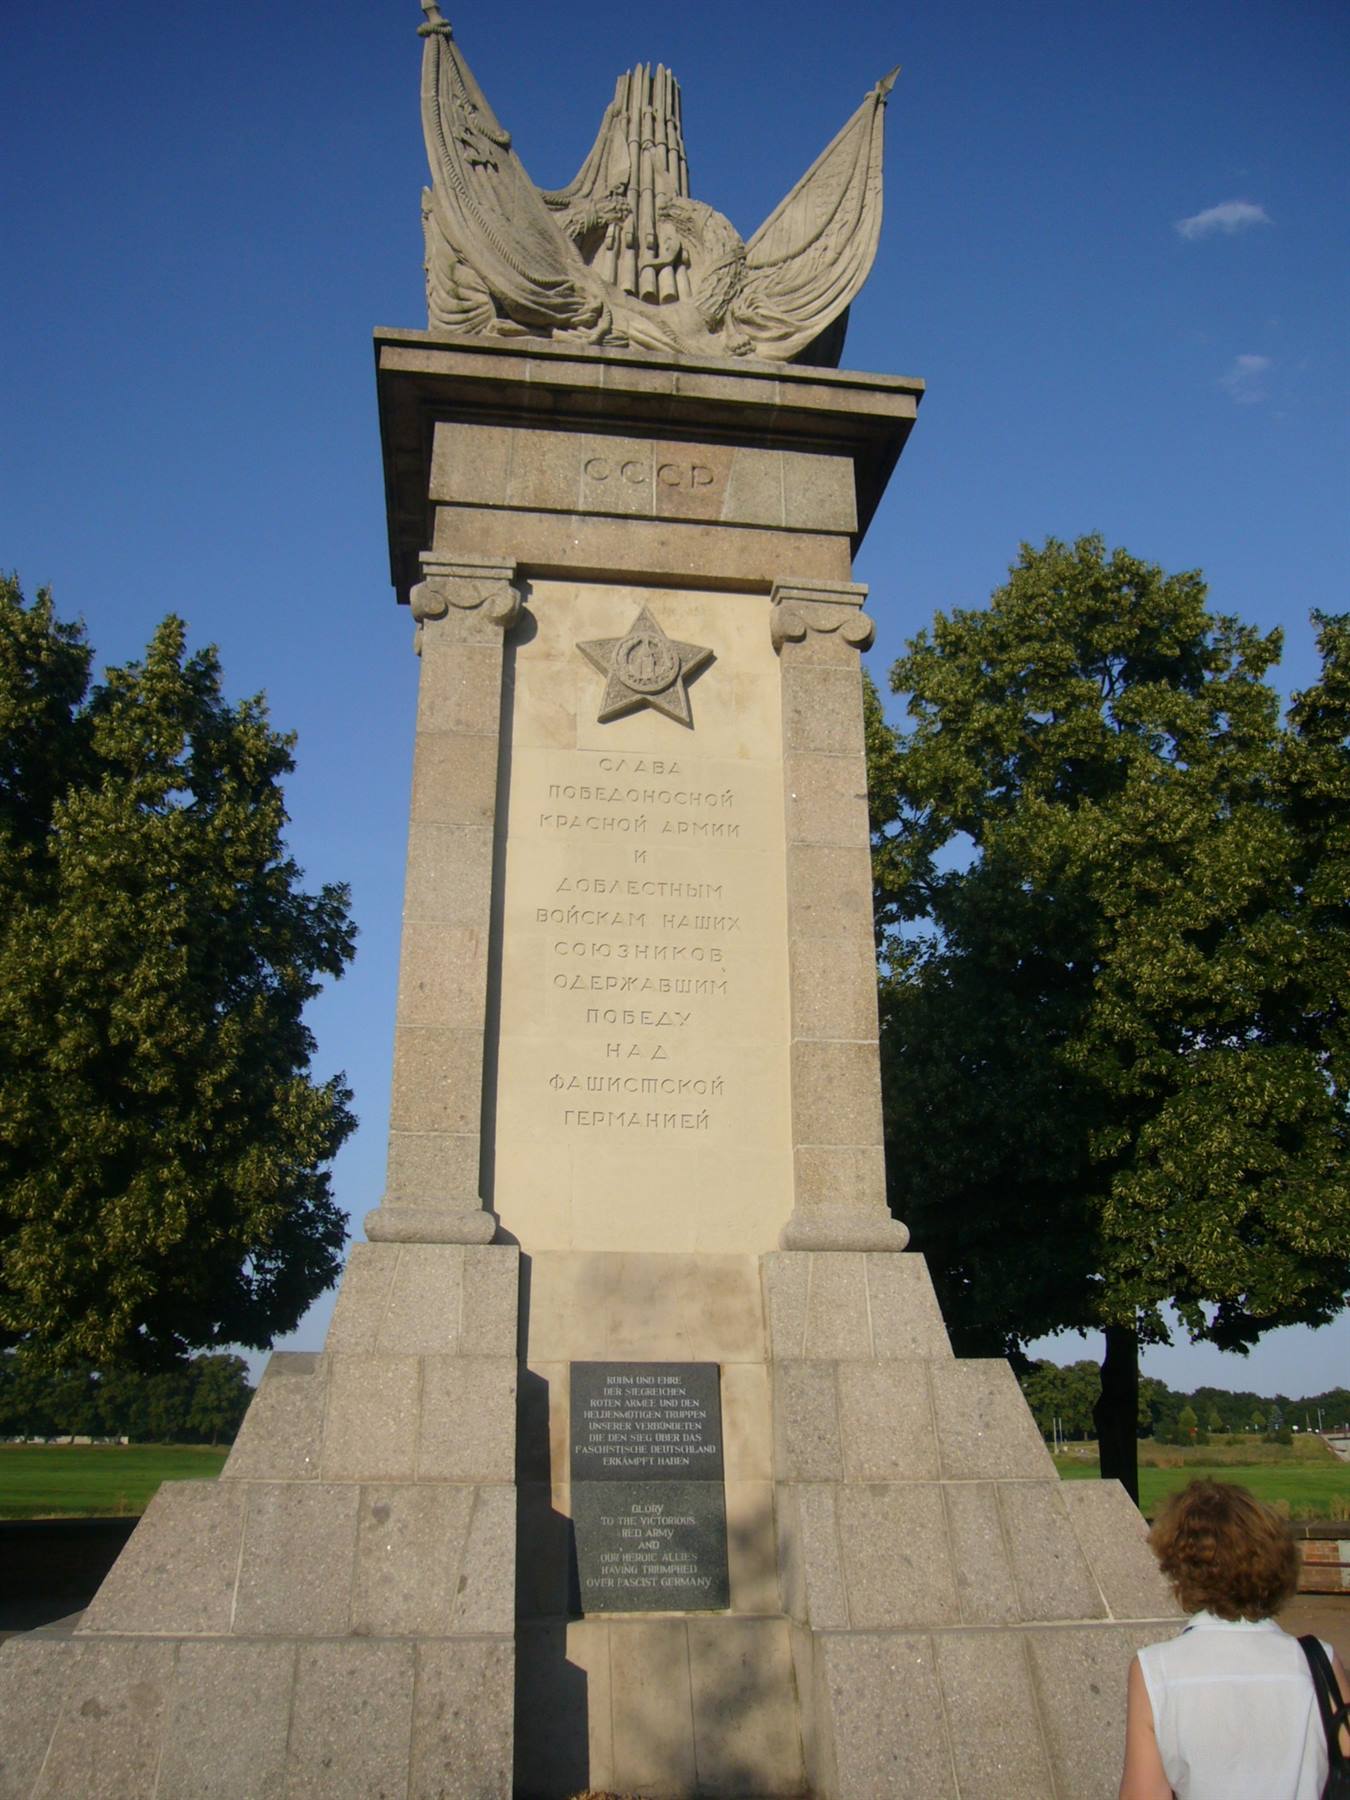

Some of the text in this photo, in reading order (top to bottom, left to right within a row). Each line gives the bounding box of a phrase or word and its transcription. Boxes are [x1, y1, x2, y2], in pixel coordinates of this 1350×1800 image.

[584, 457, 714, 488] СССР
[599, 758, 682, 775] СЛАВА
[549, 784, 735, 808] ПОБЕДОНОСНОЙ
[539, 814, 742, 838] КРАСНОЙ АРМИИ
[633, 849, 647, 864] И
[556, 877, 723, 899] ДОБЛЕСТНЫМ
[536, 905, 742, 931] ВОЙСКАМ НАШИХ
[553, 973, 728, 996] ОДЕРЖАВШИМ
[586, 1008, 693, 1027] ПОБЕДУ
[606, 1042, 668, 1060] НАД
[549, 1074, 726, 1096] ФАШИСТСКОЙ
[564, 1109, 711, 1130] ГЕРМАНИЕЙ
[606, 1376, 681, 1384] RUHM UND EHRE
[604, 1388, 686, 1396] DER SIEGREICHEN
[589, 1422, 631, 1430] UNSERER
[589, 1434, 606, 1442] DIE
[608, 1434, 626, 1442] DEN
[630, 1434, 652, 1442] SIEG
[682, 1434, 702, 1442] DAS
[650, 1445, 716, 1454] DEUTSCHLAND
[658, 1457, 690, 1465] HABEN
[632, 1504, 664, 1515] GLORY
[601, 1516, 696, 1526] TO THE VICTORIOUS
[622, 1528, 674, 1539] RED ARMY
[638, 1541, 660, 1550] AND
[601, 1564, 698, 1574] HAVING TRIUMPHED
[586, 1577, 712, 1588] OVER FASCIST GERMANY
